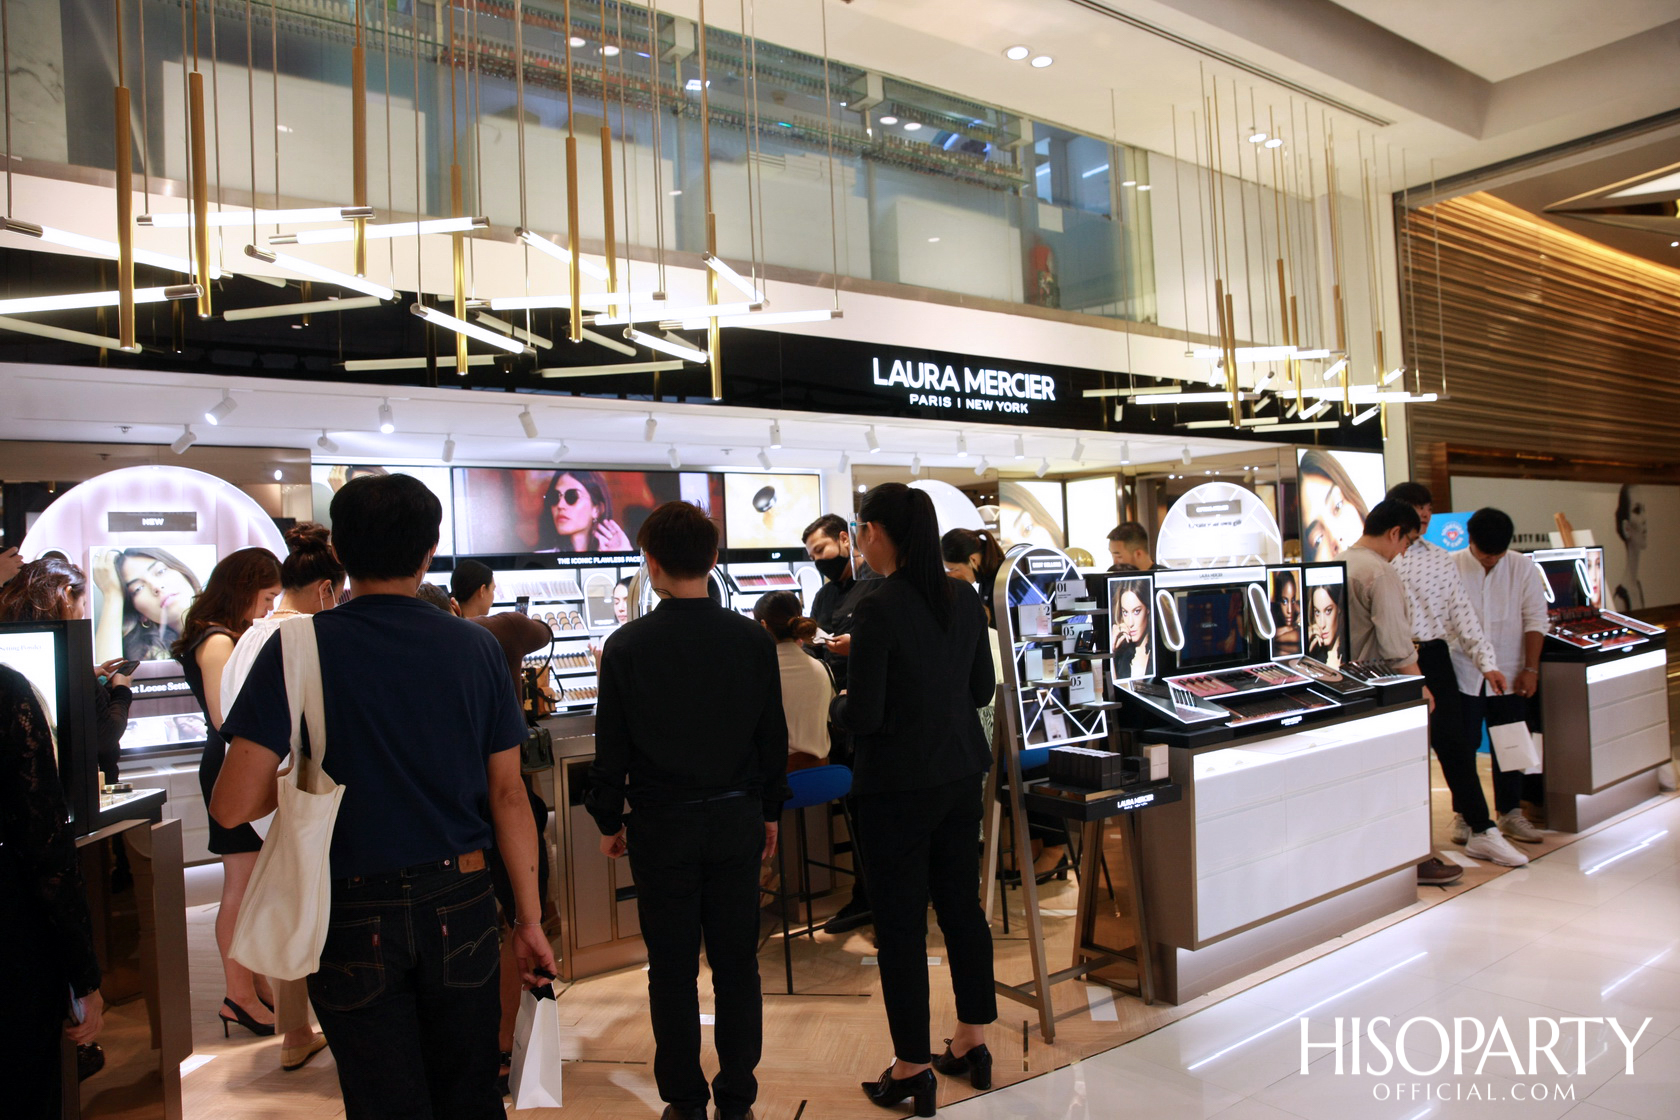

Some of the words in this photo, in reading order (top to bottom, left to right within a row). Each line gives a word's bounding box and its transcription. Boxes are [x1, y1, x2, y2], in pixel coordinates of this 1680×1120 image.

[873, 357, 961, 393] LAURA
[964, 367, 1056, 401] MERCIER
[909, 393, 952, 408] PARIS
[965, 398, 994, 411] NEW
[996, 400, 1029, 414] YORK
[142, 518, 164, 526] NEW
[594, 556, 625, 564] FLAWLESS
[1057, 583, 1067, 592] 01
[140, 684, 167, 693] Loose
